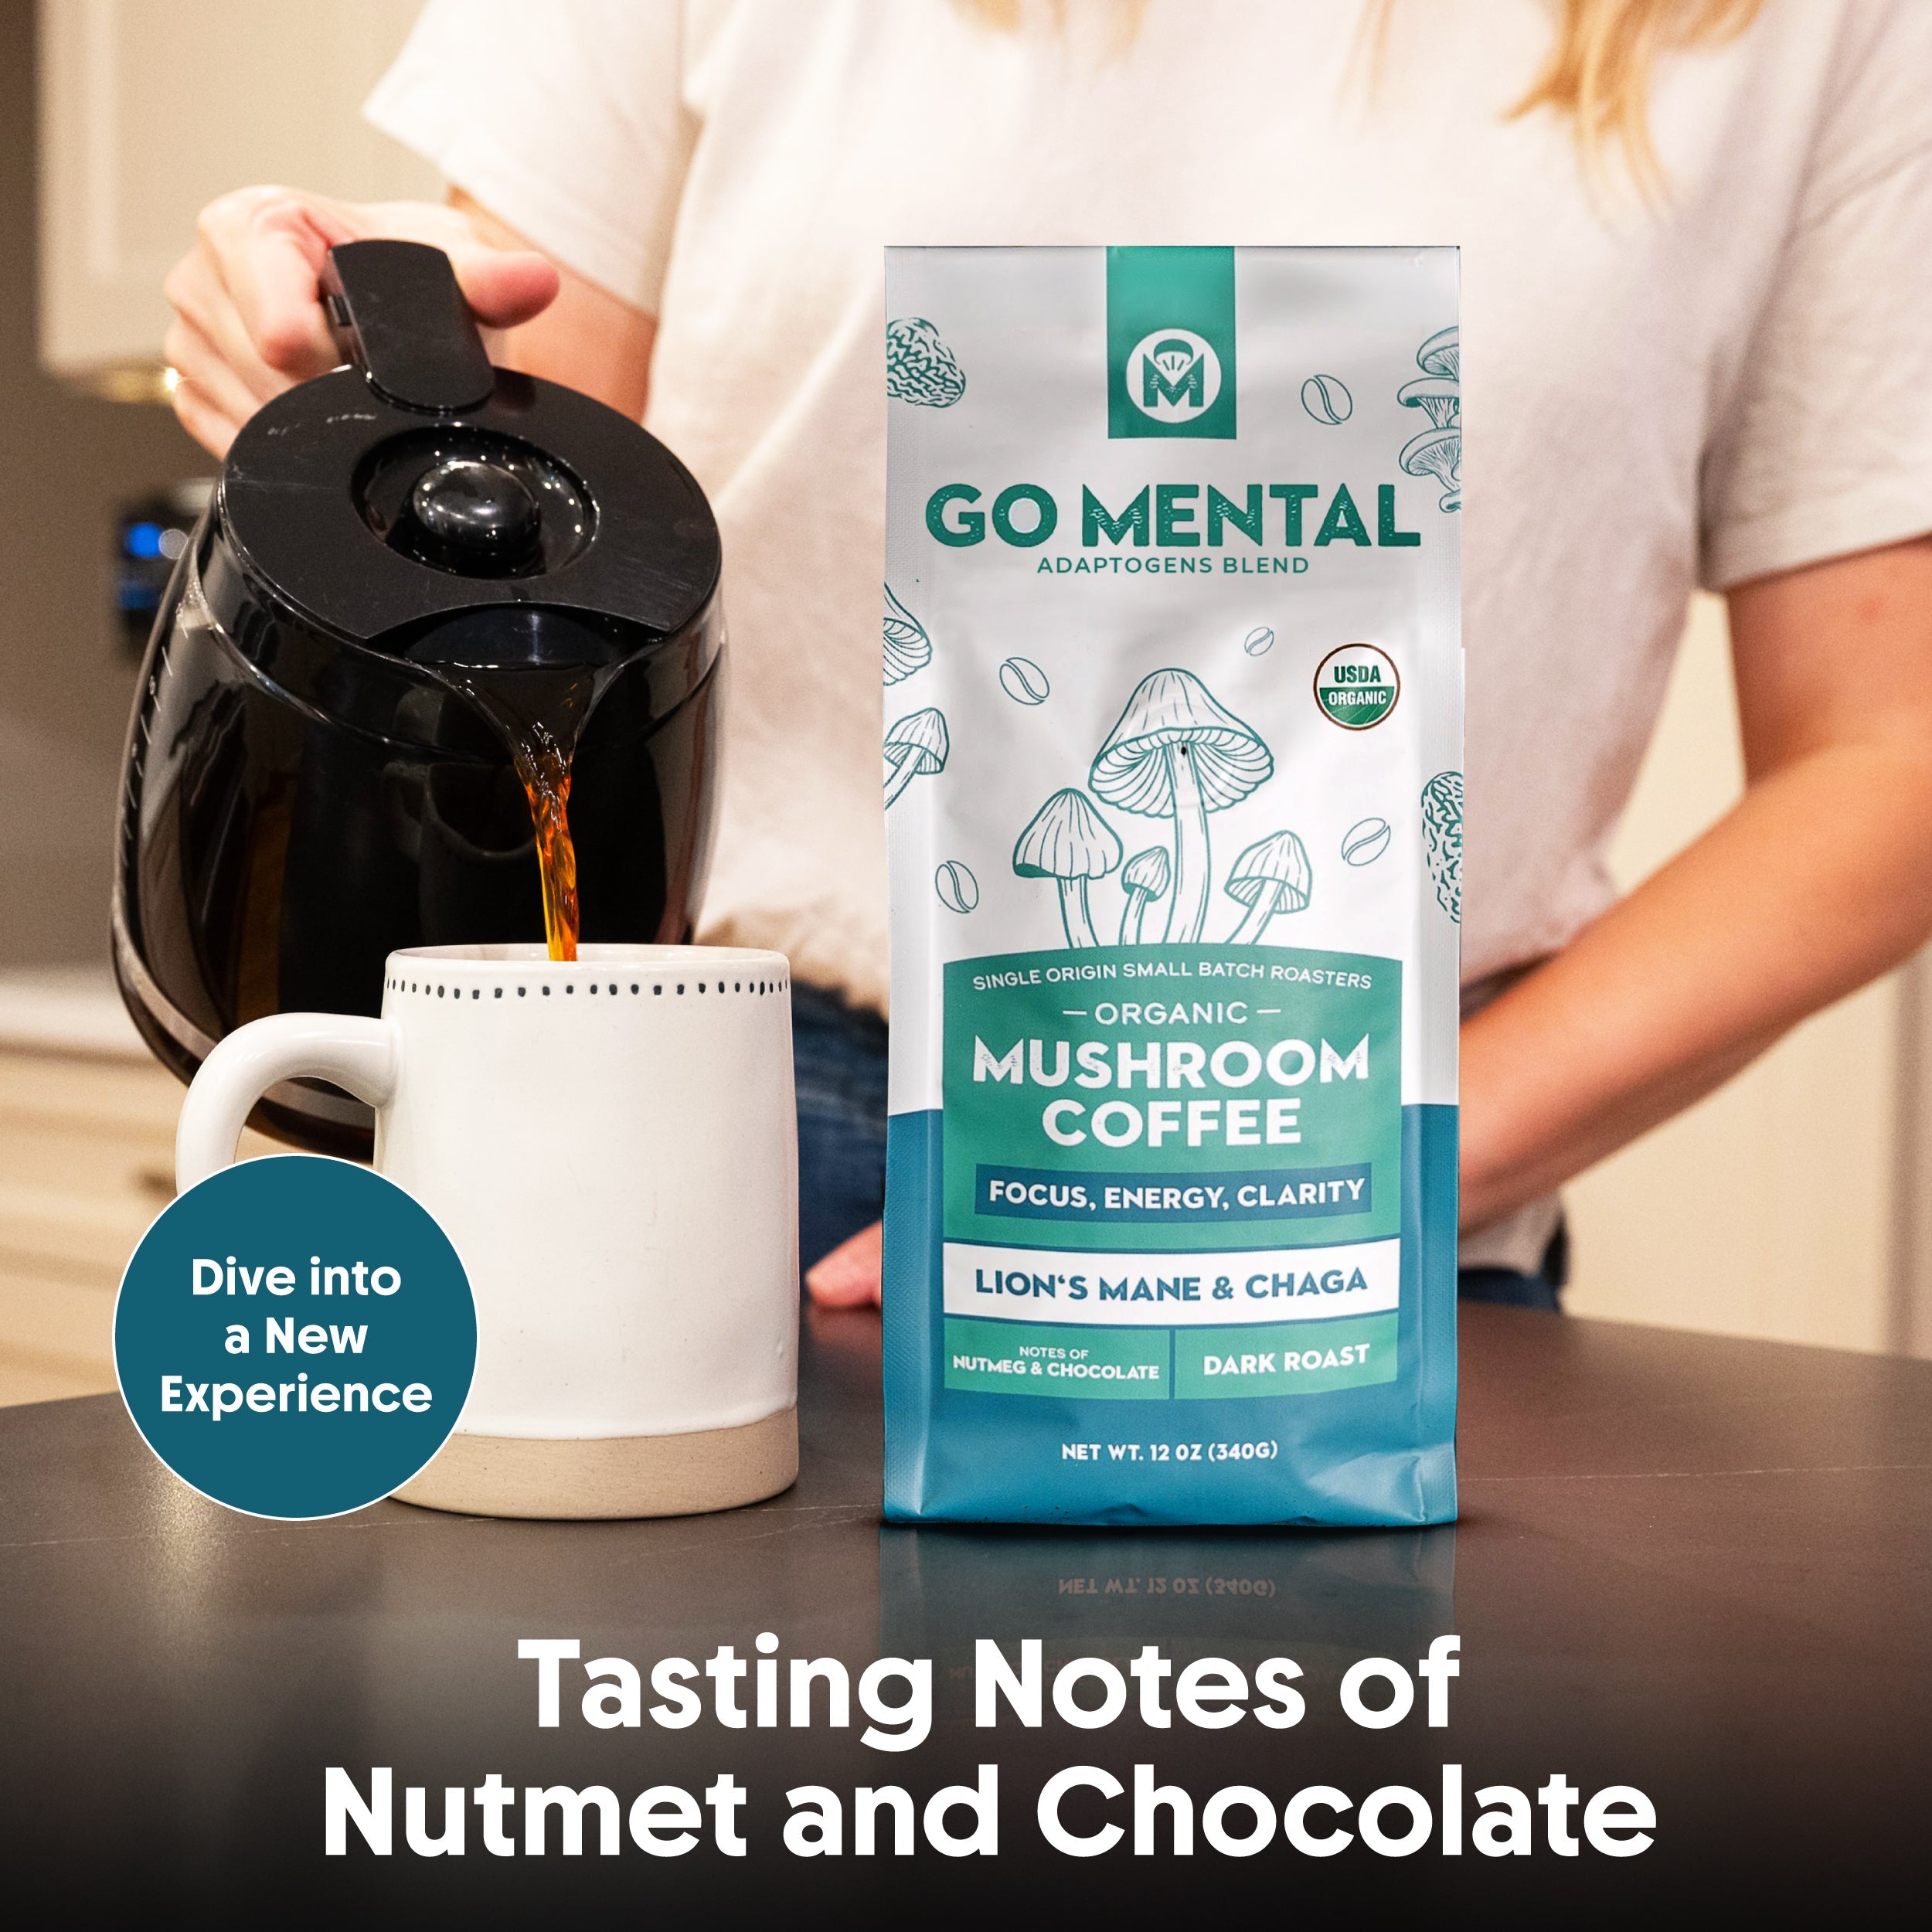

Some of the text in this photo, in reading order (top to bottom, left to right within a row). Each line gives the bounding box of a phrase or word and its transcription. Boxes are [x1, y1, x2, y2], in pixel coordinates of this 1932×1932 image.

[925, 482, 1421, 548] GO MENTAL
[1036, 556, 1309, 573] ADAPTOGENS BLEND
[1333, 665, 1382, 684] USDA
[1328, 690, 1386, 706] ORGANIC
[972, 961, 1372, 991] SINGLE ORIGIN SMALL BATCH ROASTERS
[1094, 1001, 1248, 1026] ORGANIC
[973, 1033, 1369, 1089] MUSHROOM
[1043, 1097, 1302, 1148] COFFEE
[989, 1178, 1365, 1211] FOCUS, ENERGY, CLARITY
[1099, 1277, 1201, 1301] MANE
[1212, 1276, 1234, 1301] &
[1245, 1267, 1368, 1299] CHAGA
[1019, 1345, 1089, 1360] NOTES OF
[1203, 1343, 1370, 1376] DARK ROAST
[952, 1355, 1160, 1380] NUTMEG & CHOCOLATE
[1062, 1440, 1278, 1462] NET WT. 12 OZ (340G)
